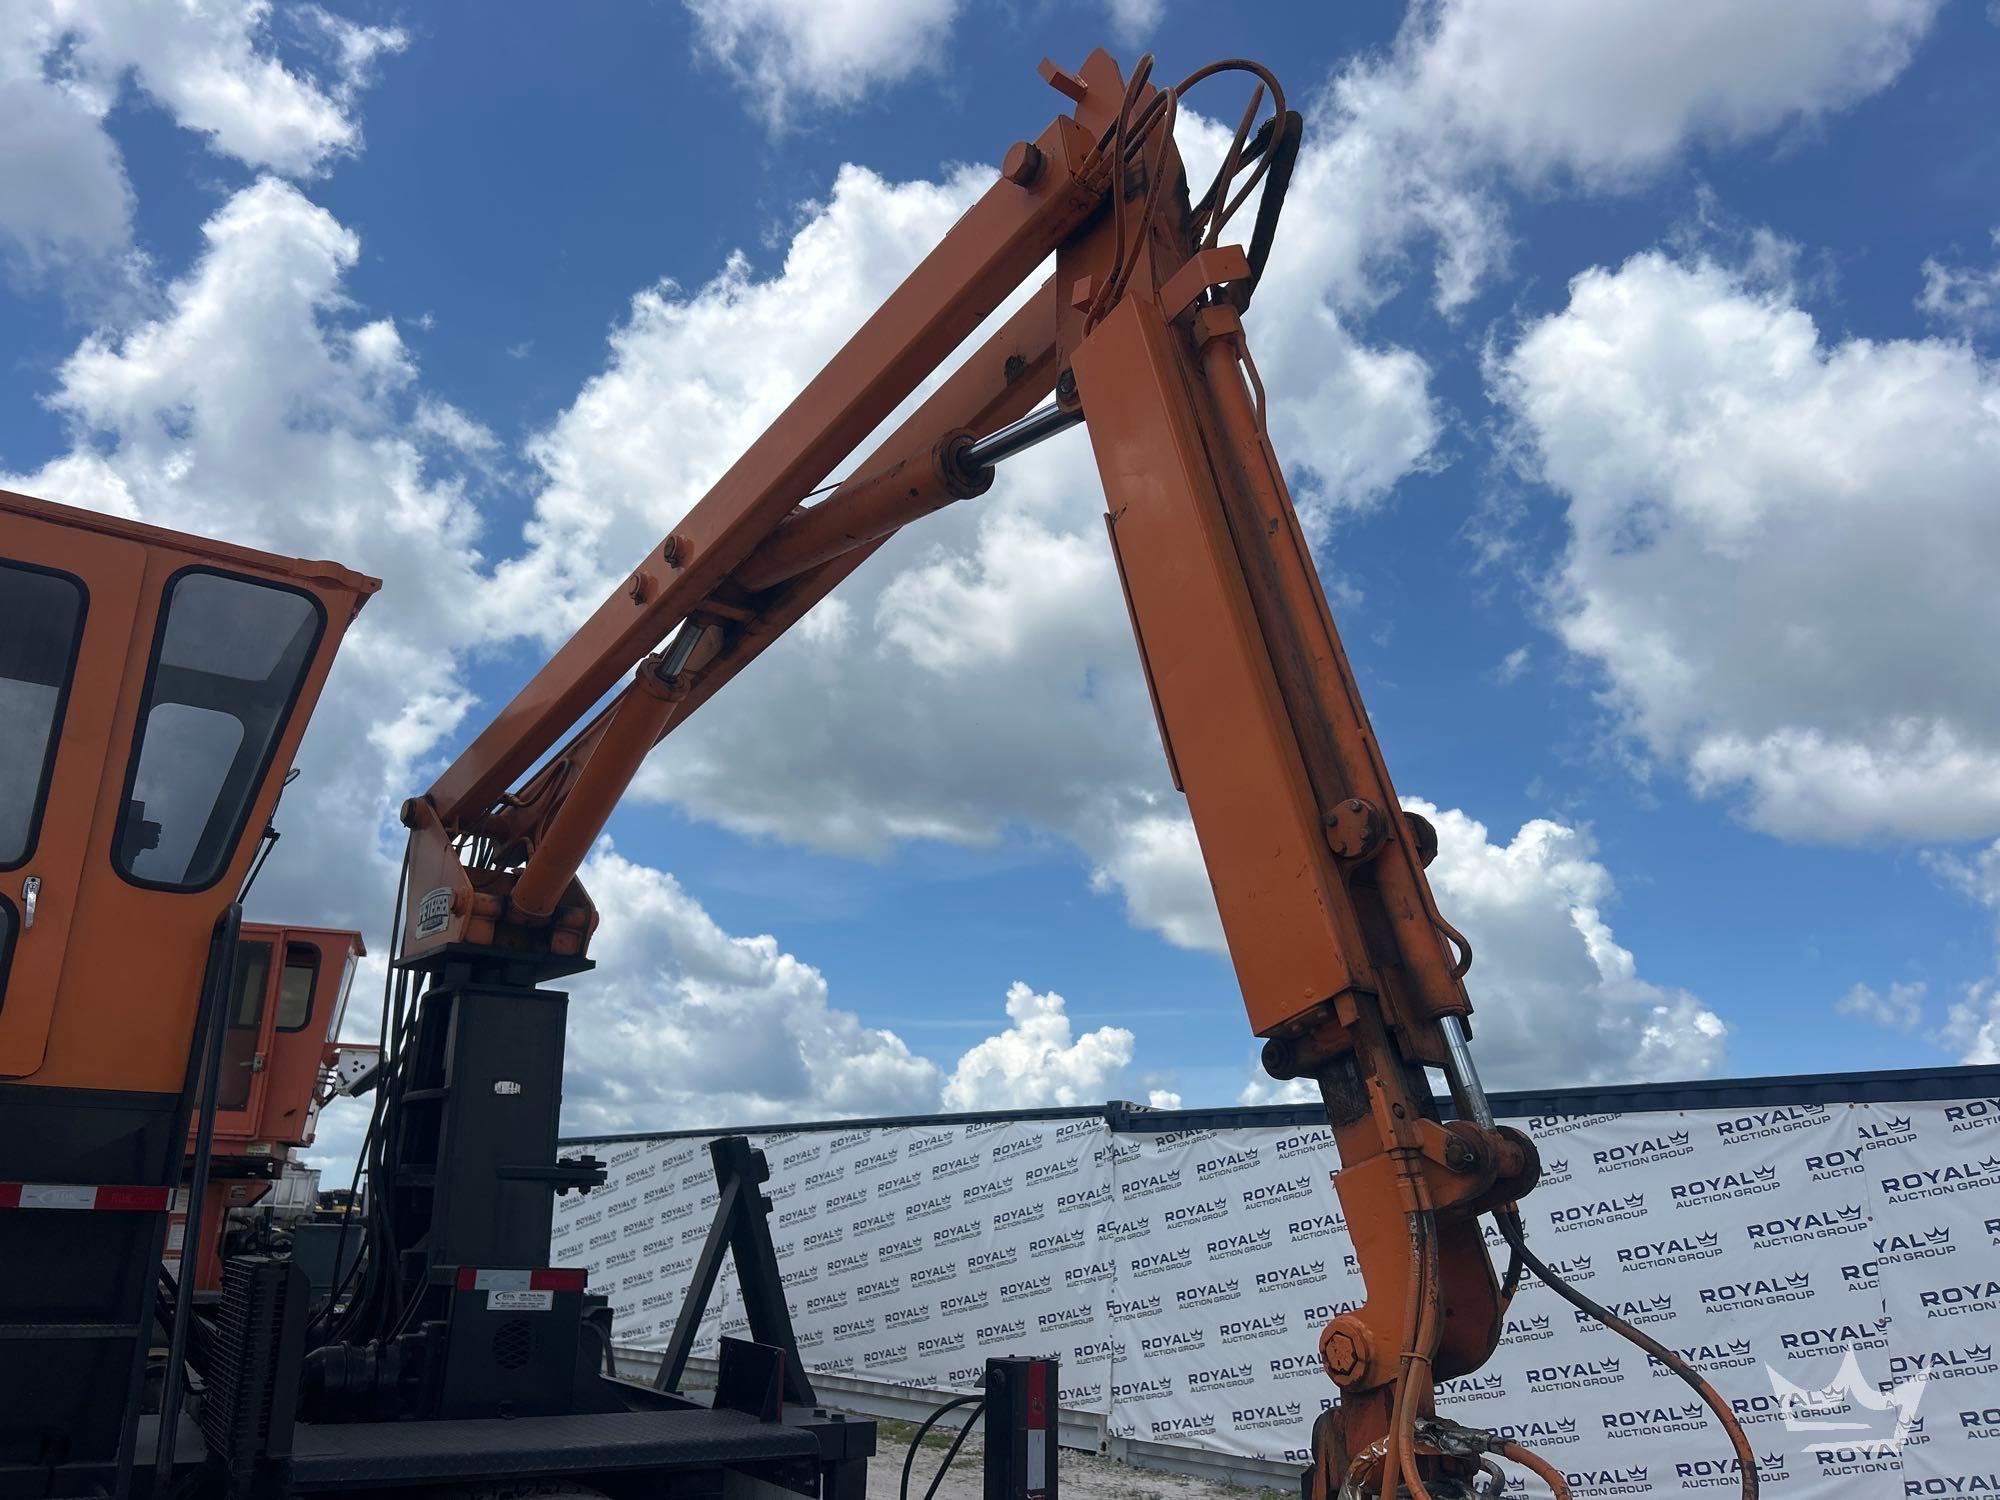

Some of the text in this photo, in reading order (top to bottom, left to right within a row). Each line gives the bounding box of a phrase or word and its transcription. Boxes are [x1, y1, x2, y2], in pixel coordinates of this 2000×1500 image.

[1532, 1113, 1622, 1140] AUCTION GROUP
[1717, 1107, 1804, 1136] ROYAL
[1723, 1115, 1831, 1145] AUCTION GROUP
[993, 1138, 1032, 1157] ROYAL
[1276, 1130, 1332, 1152] ROYAL
[1866, 1133, 1917, 1151] GROUP
[1279, 1146, 1316, 1160] AUCTION
[1593, 1138, 1670, 1165] ROYAL
[1598, 1146, 1694, 1174] AUCTION GROUP
[932, 1158, 969, 1175] ROYAL
[1025, 1162, 1066, 1180] ROYAL
[1196, 1153, 1245, 1174] ROYAL
[1199, 1160, 1260, 1181] AUCTION GROUP
[1121, 1174, 1167, 1194] ROYAL
[1670, 1172, 1755, 1199] ROYAL
[1881, 1163, 1981, 1193] ROYAL
[963, 1181, 1002, 1198] ROYAL
[1123, 1181, 1181, 1201] AUCTION GROUP
[1243, 1181, 1296, 1202] ROYAL
[1676, 1182, 1781, 1209] AUCTION GROUP
[1889, 1176, 2000, 1204] AUCTION GROU
[826, 1192, 858, 1208] ROYAL
[906, 1198, 941, 1215] ROYAL
[1245, 1189, 1312, 1210] AUCTION GROUP
[993, 1206, 1033, 1224] ROYAL
[1165, 1202, 1214, 1222] ROYAL
[1167, 1209, 1229, 1229] AUCTION GROUP
[1550, 1199, 1625, 1224] ROYAL
[1554, 1208, 1648, 1233] AUCTION GROUP
[853, 1215, 885, 1231] ROYAL
[1747, 1212, 1839, 1239] ROYAL
[804, 1231, 834, 1246] ROYAL
[934, 1224, 970, 1241] ROYAL
[1753, 1222, 1868, 1249] AUCTION GROUP
[879, 1240, 913, 1256] ROYAL
[1029, 1233, 1071, 1251] ROYAL
[1207, 1233, 1257, 1253] ROYAL
[1209, 1241, 1272, 1261] AUCTION GROUP
[1617, 1238, 1698, 1263] ROYAL
[968, 1250, 1006, 1267] ROYAL
[1131, 1252, 1178, 1270] ROYAL
[1622, 1248, 1723, 1272] AUCTION GROUP
[1903, 1245, 1956, 1261] GROUP
[910, 1266, 946, 1282] ROYAL
[1133, 1260, 1192, 1278] AUCTION GROUP
[1255, 1265, 1310, 1285] ROYAL
[857, 1280, 890, 1296] ROYAL
[1000, 1279, 1040, 1296] ROYAL
[1176, 1283, 1226, 1302] ROYAL
[1258, 1274, 1327, 1293] AUCTION GROUP
[1699, 1278, 1788, 1303] ROYAL
[940, 1294, 978, 1310] ROYAL
[1179, 1292, 1241, 1310] AUCTION GROUP
[1706, 1290, 1815, 1314] AUCTION GROUP
[1920, 1281, 2000, 1307] ROYA
[885, 1308, 919, 1323] ROYAL
[1038, 1309, 1080, 1325] ROYAL
[1632, 1311, 1675, 1324] GROUP
[1927, 1301, 1996, 1319] AUCTION
[833, 1321, 866, 1335] ROYAL
[976, 1323, 1015, 1339] ROYAL
[1219, 1317, 1272, 1336] ROYAL
[1222, 1327, 1287, 1344] AUCTION GROUP
[917, 1336, 954, 1351] ROYAL
[1141, 1333, 1191, 1350] ROYAL
[1515, 1331, 1554, 1343] GROUP
[1780, 1324, 1876, 1349] ROYAL
[1143, 1342, 1205, 1358] AUCTION GROUP
[1788, 1339, 1888, 1360] AUCTION GRO
[1709, 1356, 1756, 1369] GROUP
[1890, 1350, 1967, 1373] OYAL
[1188, 1367, 1239, 1385] ROYAL
[1526, 1362, 1601, 1383] ROYAL
[1942, 1364, 1999, 1378] GROUP
[1111, 1380, 1159, 1397] ROYAL
[1191, 1377, 1254, 1393] AUCTION GROUP
[1531, 1375, 1624, 1393] AUCTION GROUP
[1113, 1390, 1173, 1404] AUCTION GROUP
[1468, 1390, 1506, 1401] GROUP
[1731, 1392, 1823, 1414] ROYAL
[1232, 1405, 1287, 1422] ROYAL
[1602, 1407, 1683, 1428] ROYAL
[1739, 1406, 1851, 1424] AUCTION GROUP
[1150, 1417, 1201, 1433] ROYAL
[1235, 1416, 1303, 1431] AUCTION GROUP
[1607, 1421, 1708, 1439] AUCTION GROUP
[1152, 1428, 1216, 1441] AUCTION GROUP
[1540, 1435, 1580, 1445] GROUP
[1823, 1463, 1888, 1477] AUCTION
[1612, 1484, 1652, 1494] GROUP
[1682, 1476, 1740, 1488] AUCTION
